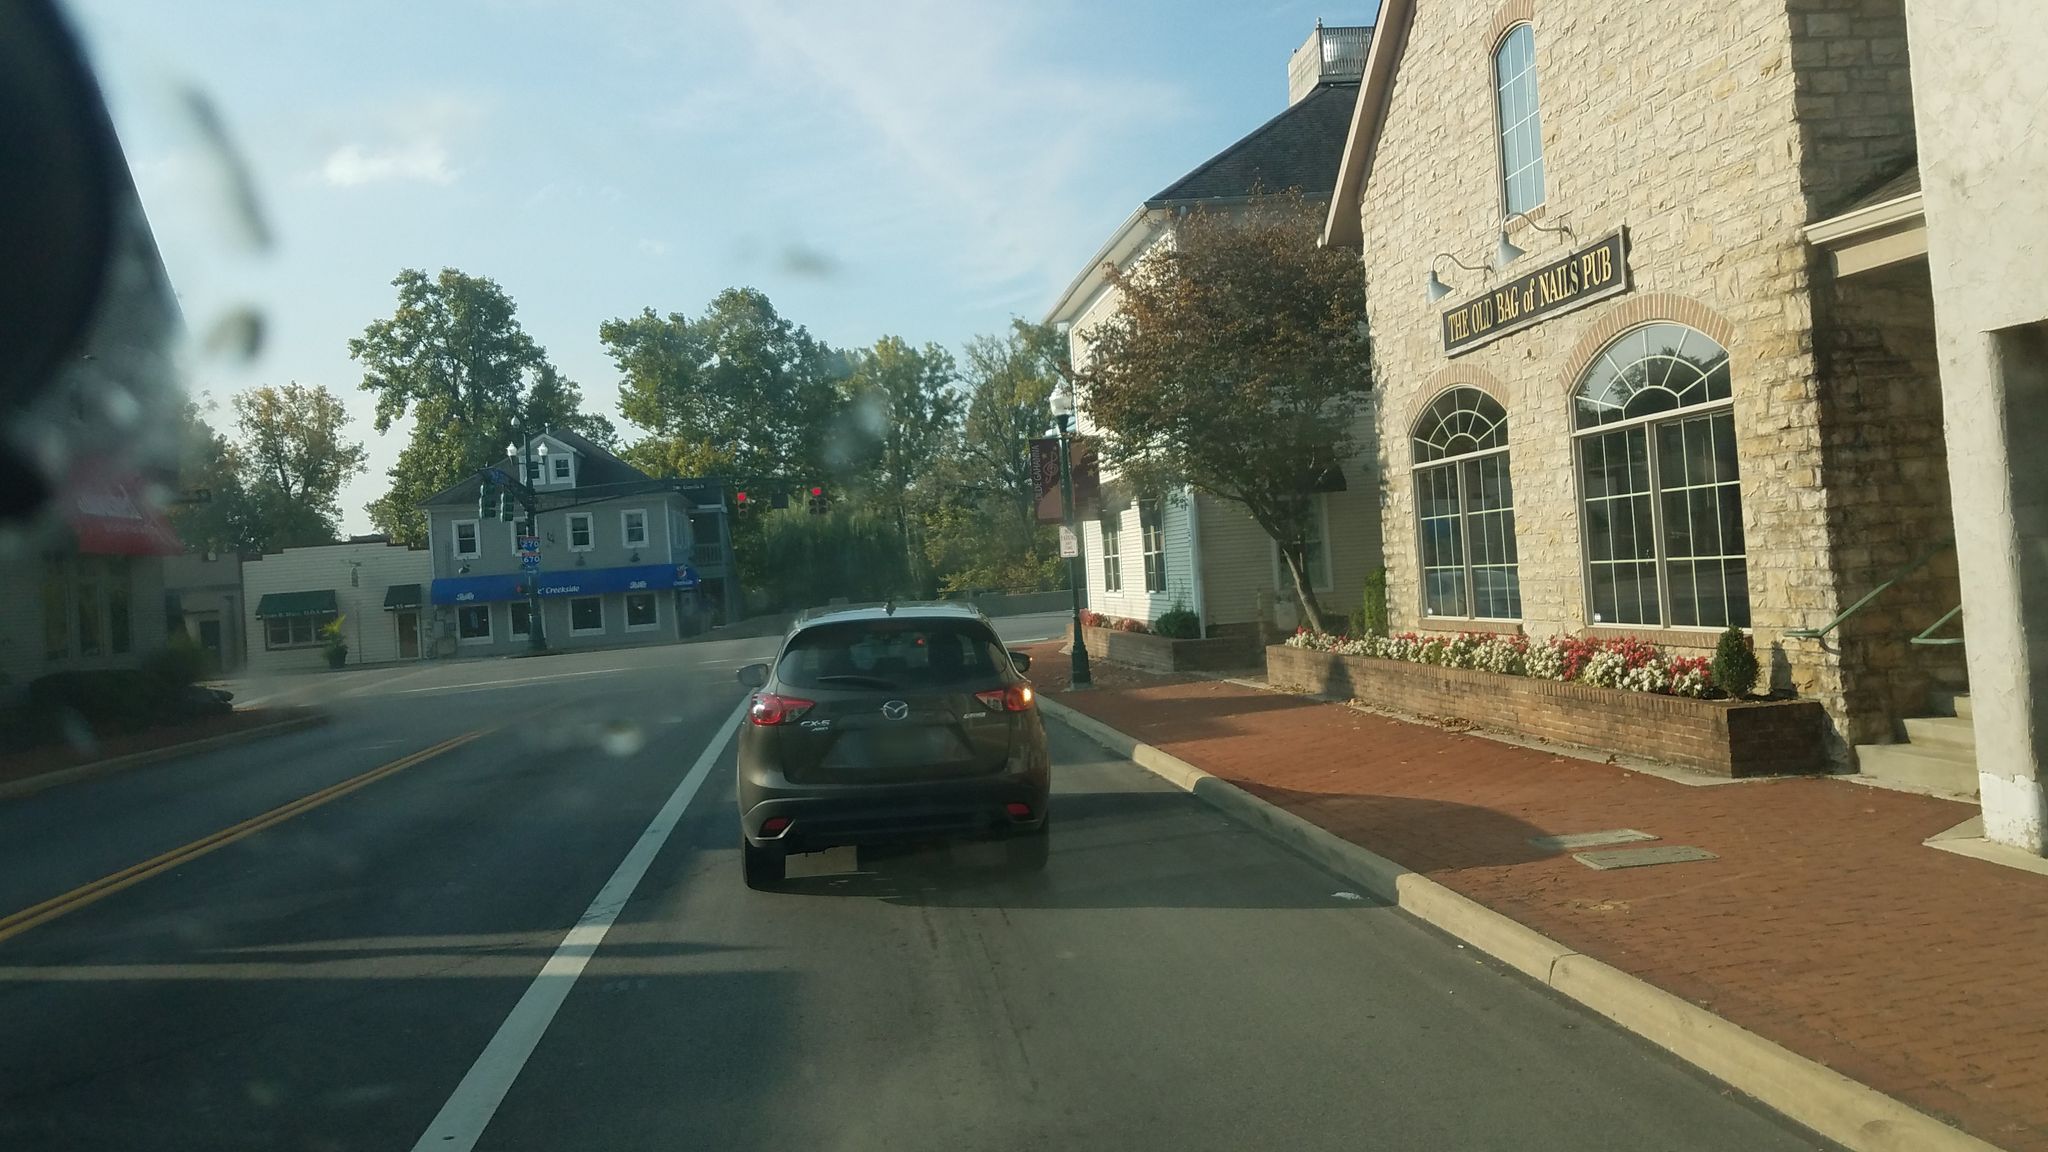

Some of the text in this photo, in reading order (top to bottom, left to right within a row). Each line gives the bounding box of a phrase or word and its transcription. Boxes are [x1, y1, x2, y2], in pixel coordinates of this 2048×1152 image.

[1447, 245, 1612, 343] THE OLD BAG of NAILS PUB
[546, 584, 580, 595] Creekside
[800, 719, 831, 727] CX-5
